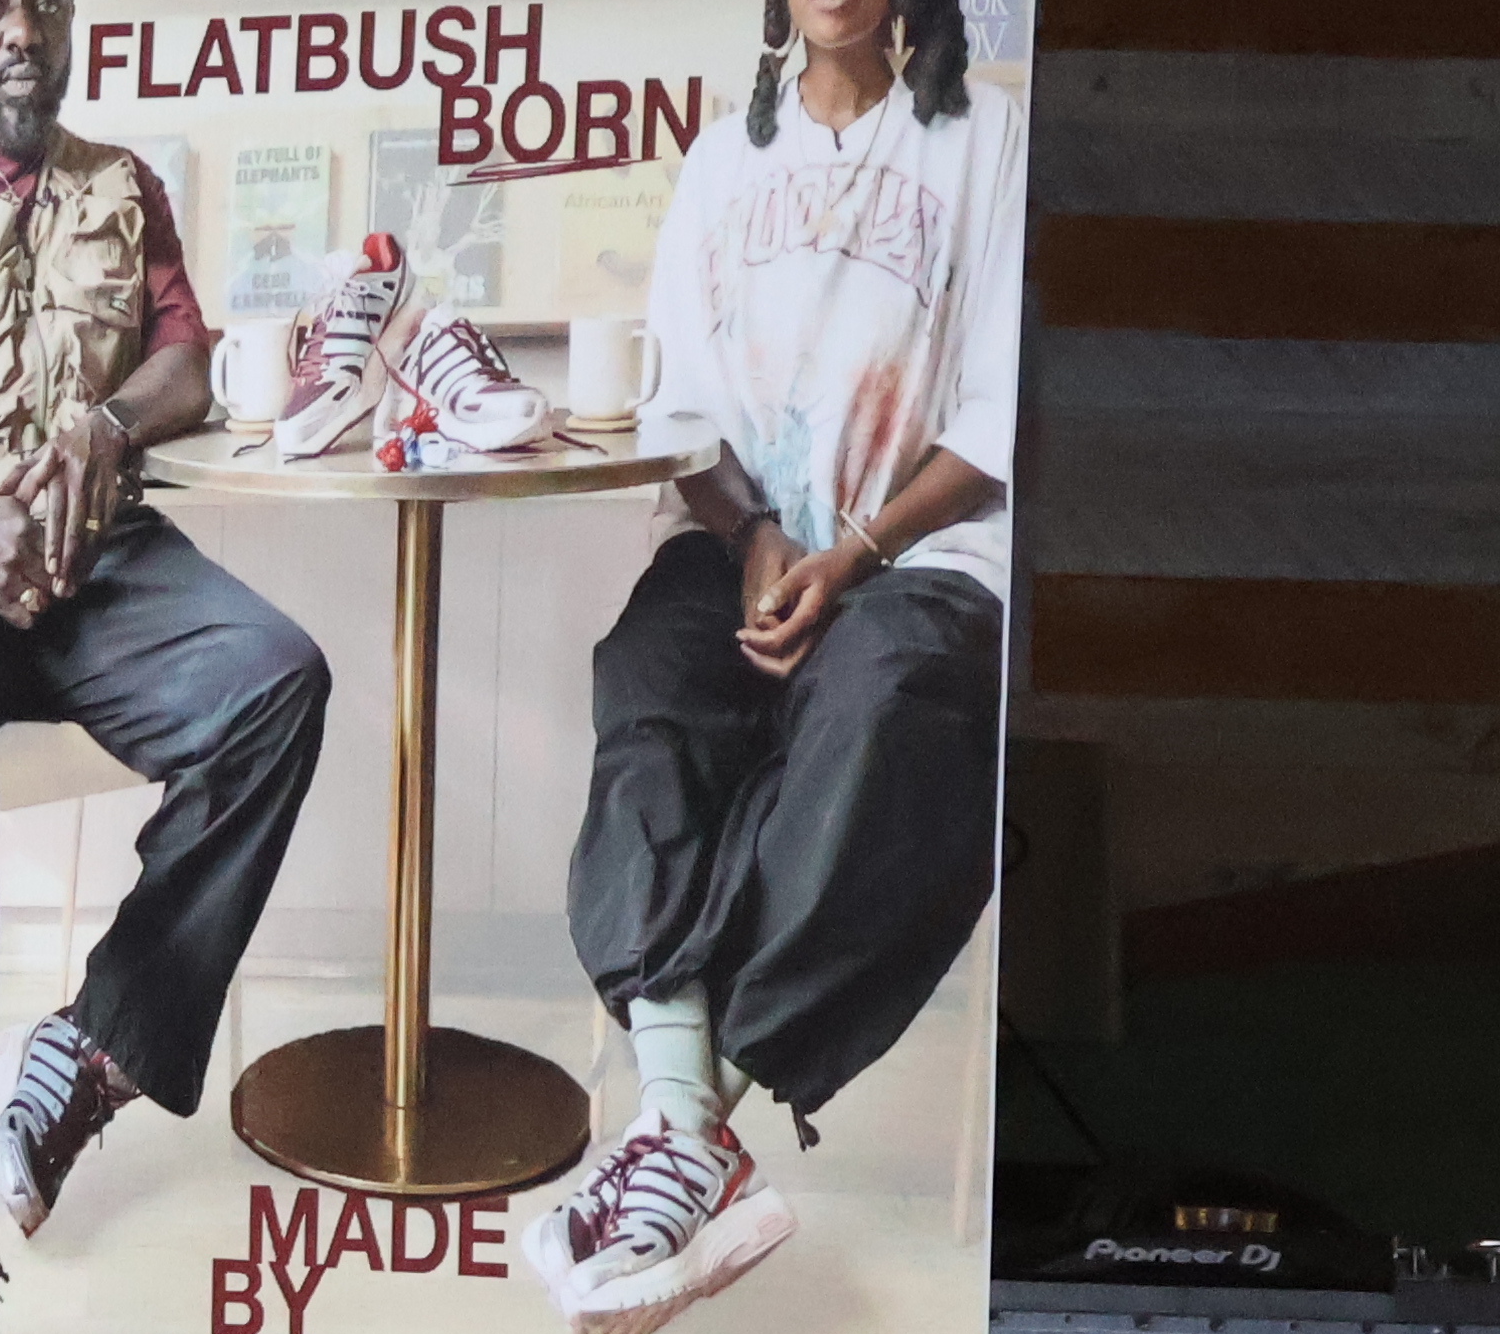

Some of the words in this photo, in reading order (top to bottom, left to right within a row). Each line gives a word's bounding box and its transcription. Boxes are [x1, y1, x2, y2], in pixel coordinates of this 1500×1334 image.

[87, 4, 544, 100] FLATBUSH
[436, 76, 703, 166] BORN
[249, 1184, 511, 1279] MADE
[1084, 1238, 1233, 1264] Pioneer
